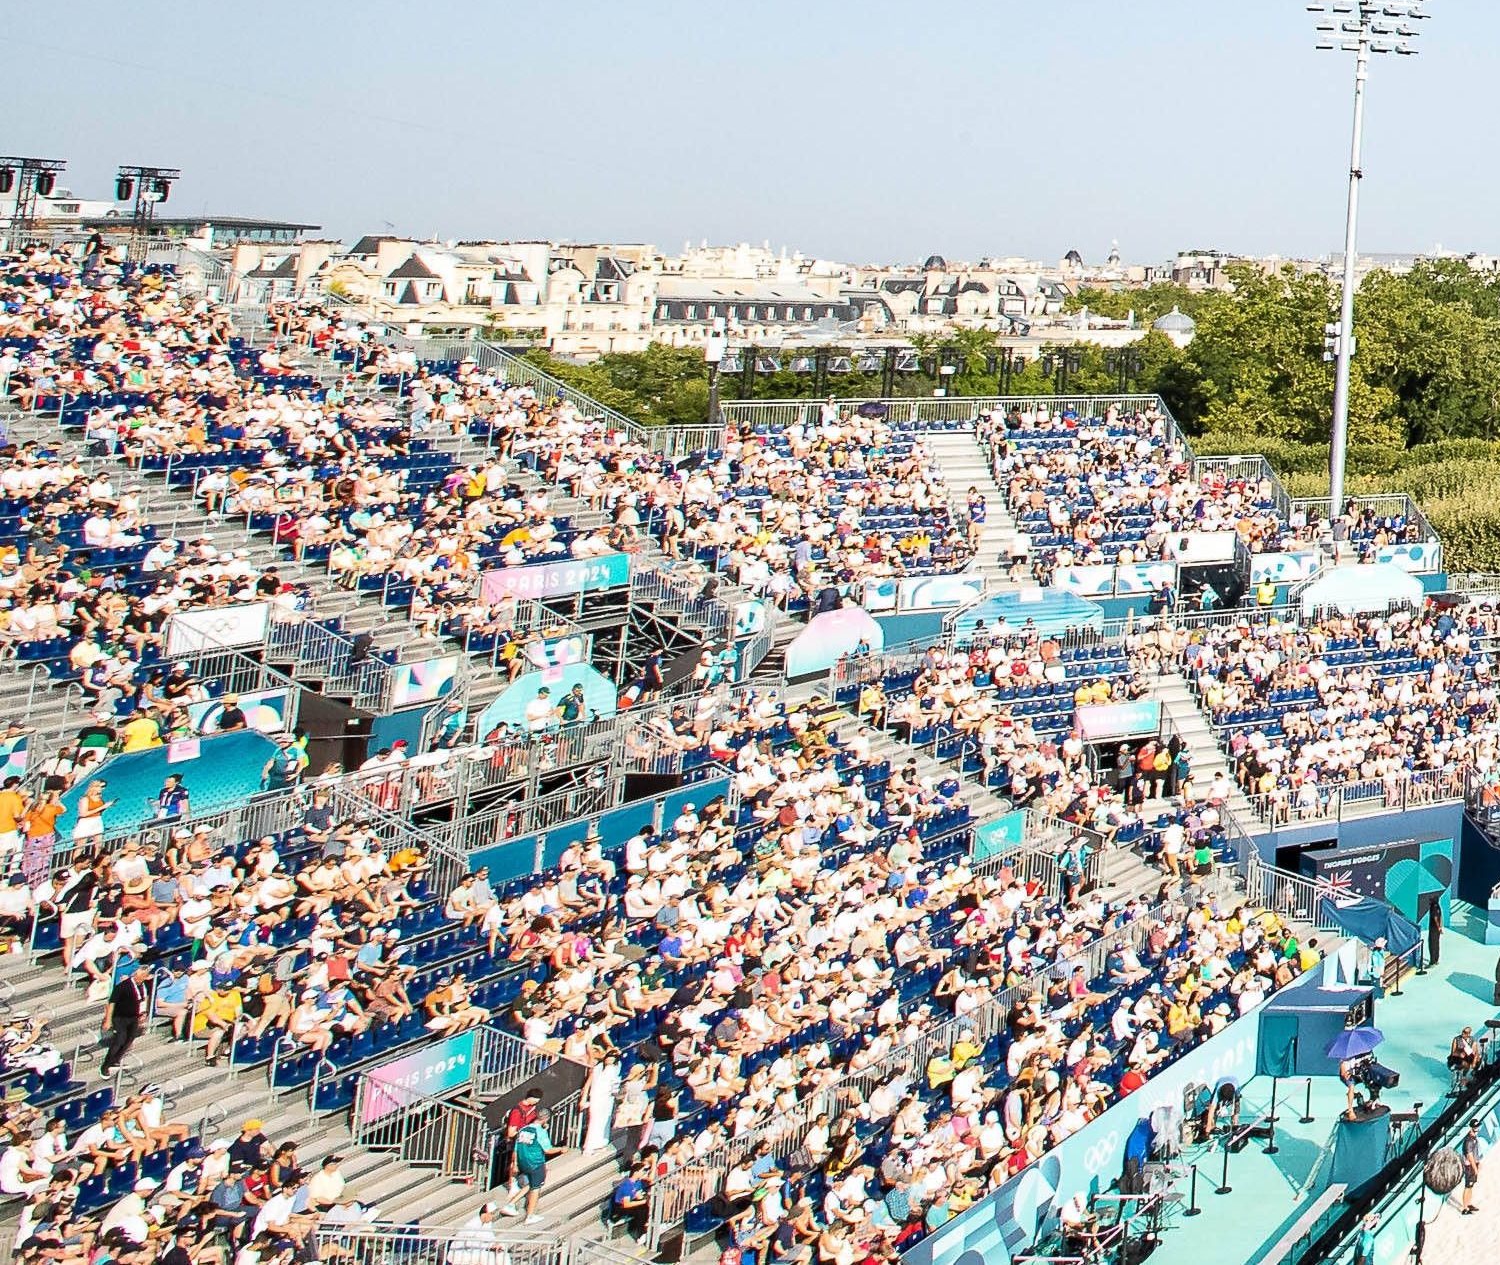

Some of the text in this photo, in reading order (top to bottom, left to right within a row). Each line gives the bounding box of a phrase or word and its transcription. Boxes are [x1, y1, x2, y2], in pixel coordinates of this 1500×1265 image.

[506, 564, 610, 591] PARIS 2024
[425, 1054, 465, 1079] 2024
